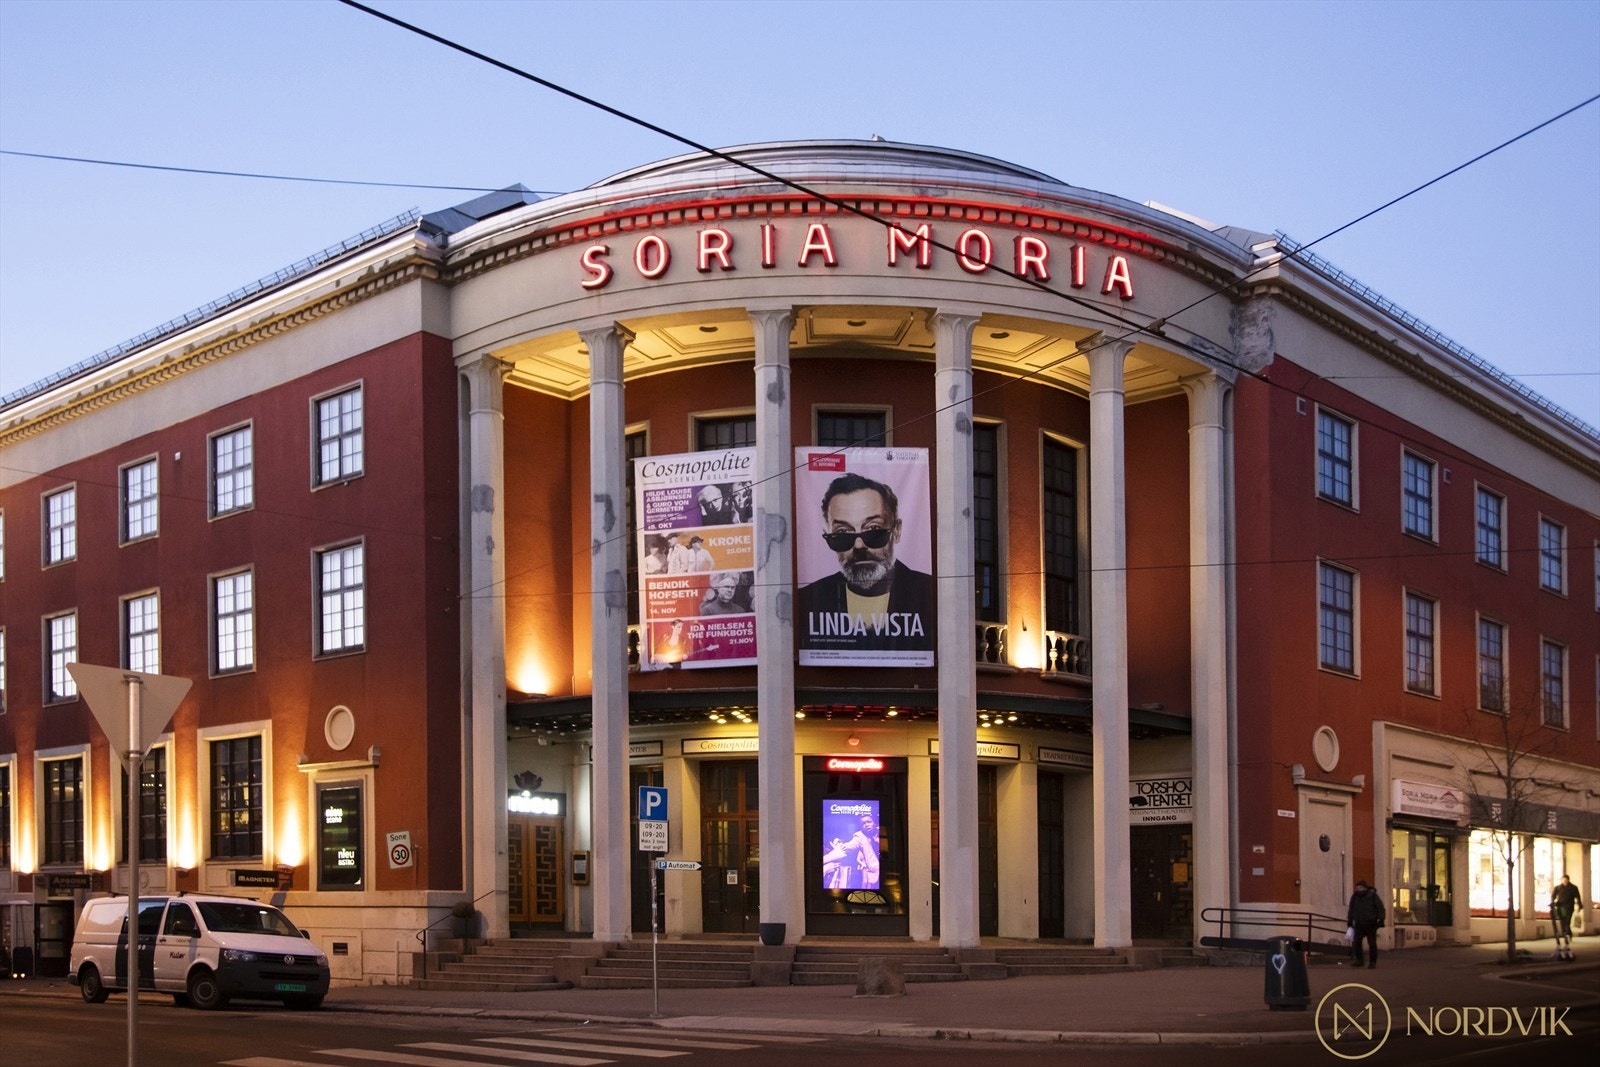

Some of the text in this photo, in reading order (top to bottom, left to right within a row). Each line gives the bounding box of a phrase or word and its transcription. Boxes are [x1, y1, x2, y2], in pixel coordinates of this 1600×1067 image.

[580, 223, 1135, 300] SORIA MORIA
[642, 452, 750, 480] Cosmopolite
[669, 473, 729, 484] SCENE OSLO
[645, 488, 692, 498] HILDE LOUISE
[646, 505, 684, 514] GERMETEN
[708, 535, 751, 547] KROKE
[648, 580, 690, 590] BENDIK
[648, 588, 699, 600] HOFSETH
[690, 621, 753, 632] IDA NIELSEN &
[809, 611, 925, 637] LINDA VISTA
[705, 629, 753, 638] FUNKBOTS
[700, 739, 758, 751] Cosmopolite
[828, 758, 883, 772] Cosmopolite
[646, 791, 661, 816] P
[1146, 793, 1192, 807] TEATRET
[830, 804, 872, 815] Cosmopolite
[389, 834, 407, 842] Sone
[337, 848, 355, 859] nieu
[394, 849, 407, 860] 30
